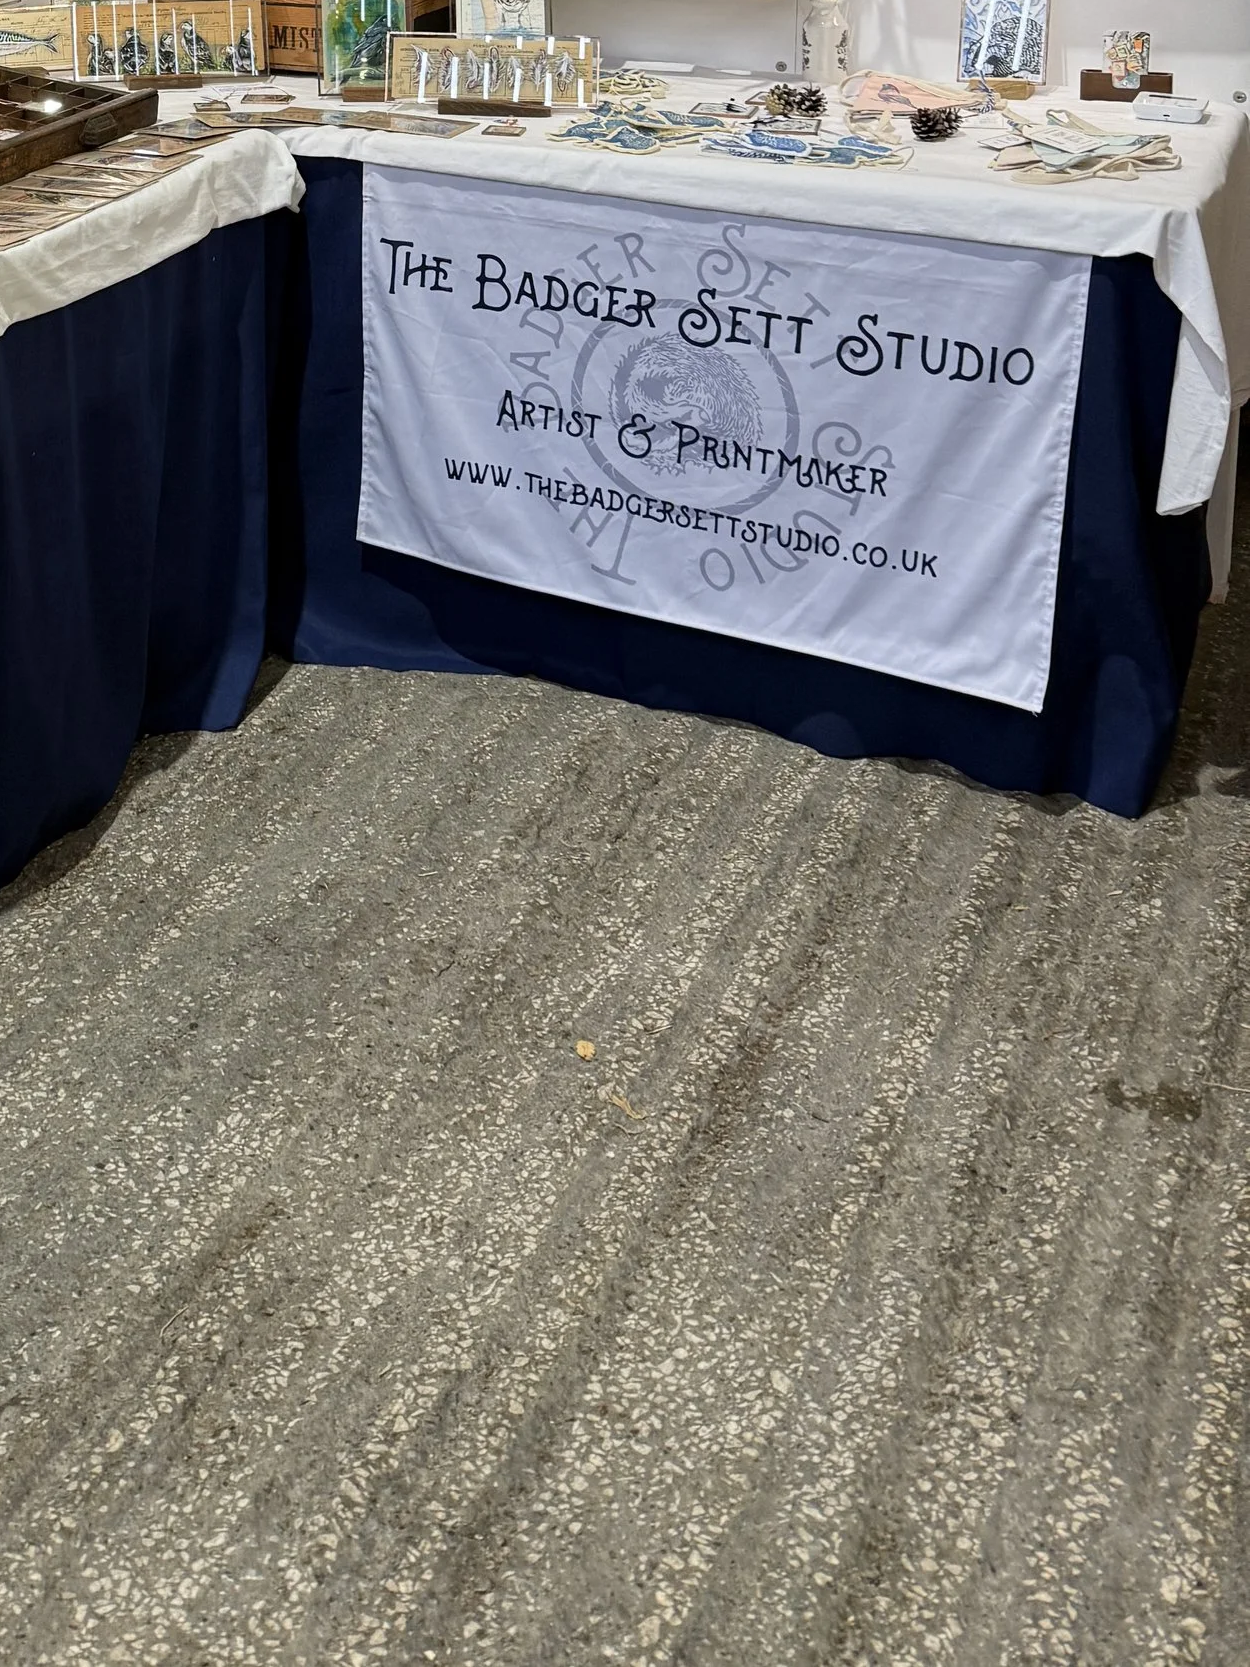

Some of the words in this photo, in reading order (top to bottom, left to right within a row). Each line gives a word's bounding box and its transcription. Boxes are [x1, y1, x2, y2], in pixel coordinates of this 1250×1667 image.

[471, 253, 657, 329] BADGER
[677, 287, 814, 354] SETT
[835, 313, 1035, 386] STUDIO
[496, 389, 602, 439] ARTIST
[617, 413, 656, 459] &
[670, 420, 888, 497] PRINTMAKER
